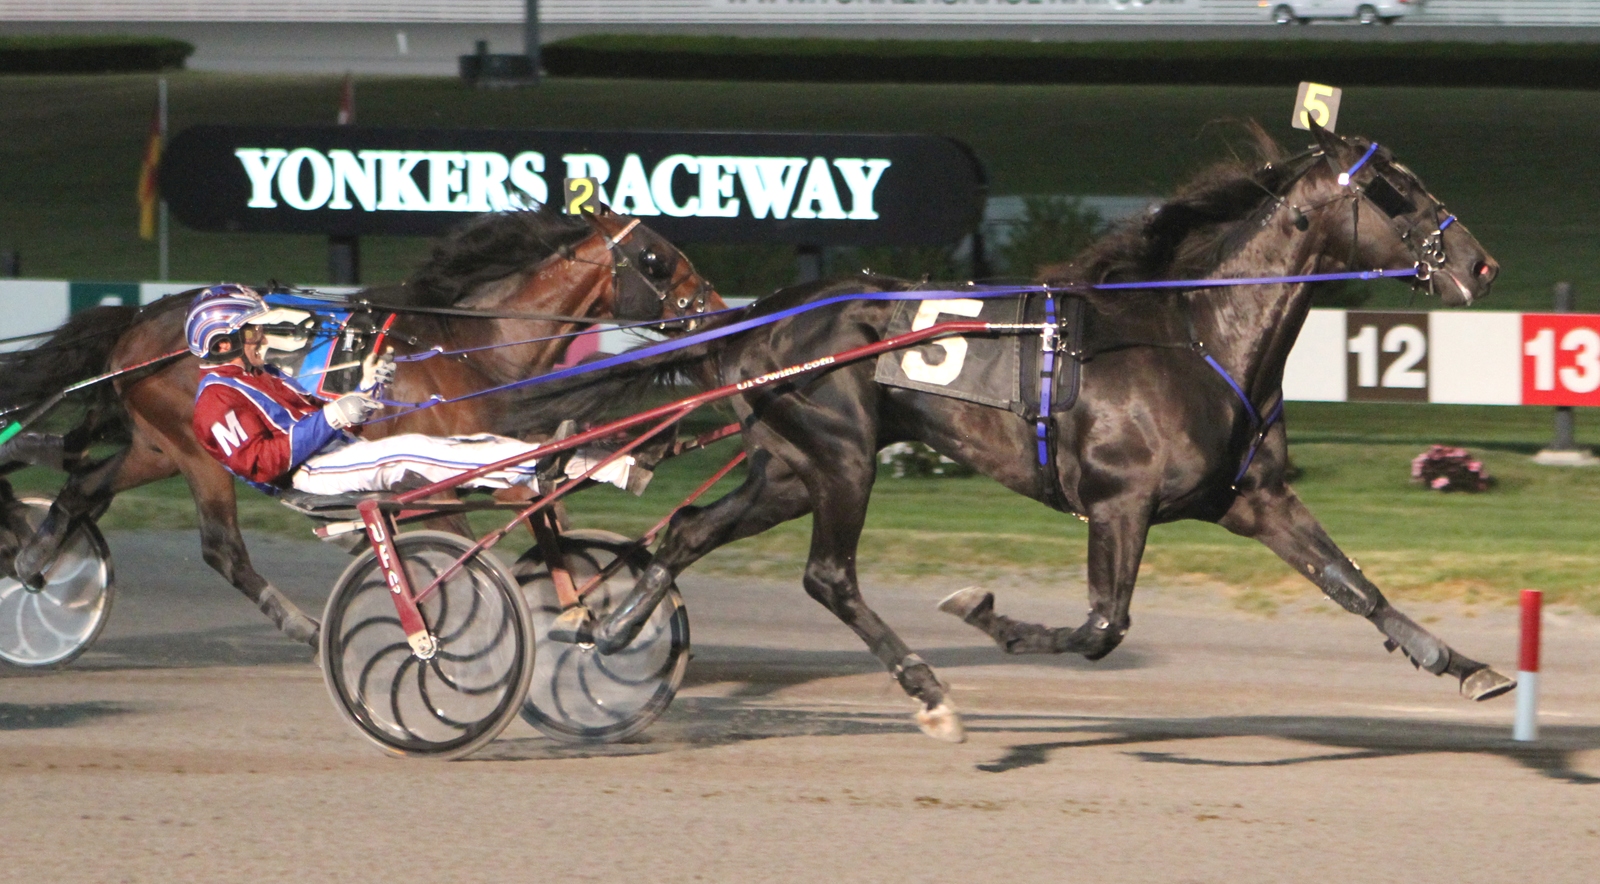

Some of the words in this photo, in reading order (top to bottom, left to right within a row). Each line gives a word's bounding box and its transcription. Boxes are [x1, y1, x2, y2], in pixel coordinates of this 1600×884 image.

[1300, 83, 1330, 129] 5
[234, 147, 547, 212] YONKERS
[562, 153, 891, 220] RACEWAY
[569, 178, 594, 214] 2
[901, 298, 984, 386] 5
[1348, 325, 1426, 388] 12
[1524, 327, 1600, 393] 13
[211, 409, 249, 457] M
